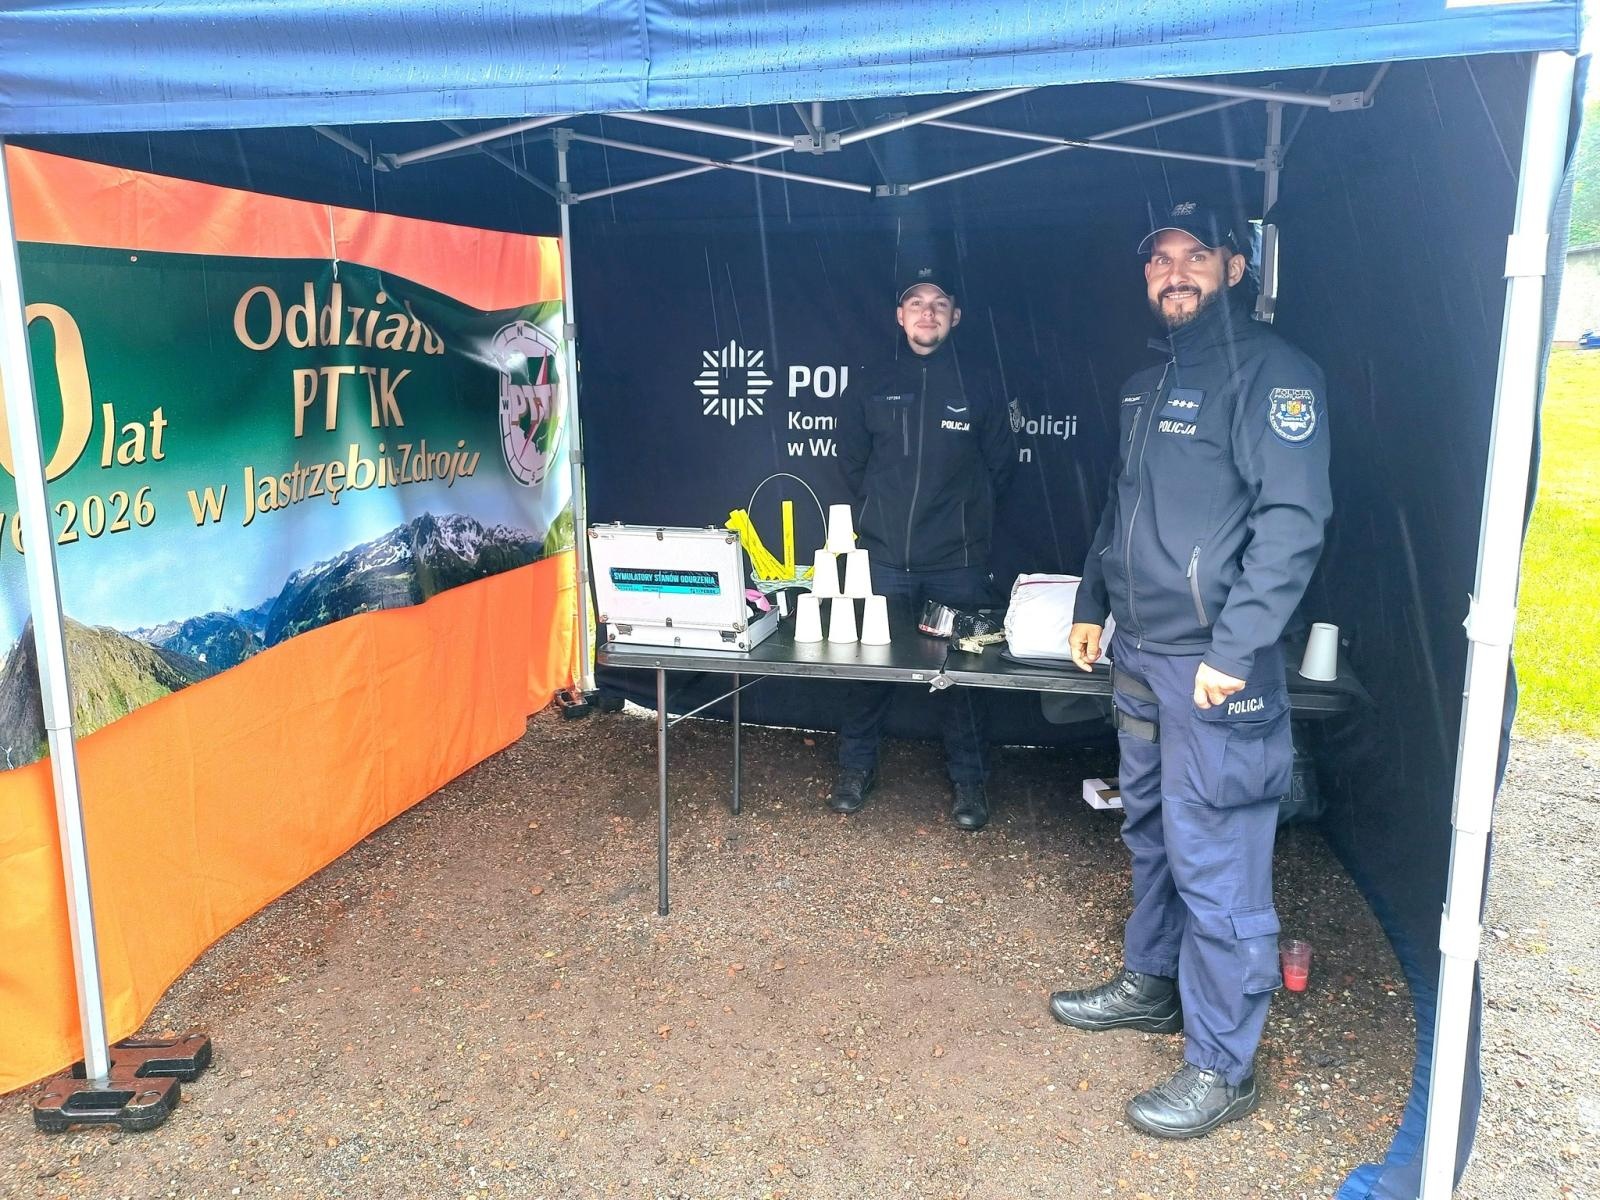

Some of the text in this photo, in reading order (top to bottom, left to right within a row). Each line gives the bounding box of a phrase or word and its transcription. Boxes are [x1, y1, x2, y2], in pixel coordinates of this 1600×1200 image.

[516, 326, 523, 337] N
[293, 365, 411, 439] PTTK
[502, 399, 509, 411] W
[508, 384, 558, 425] PTT
[788, 410, 838, 431] Kom
[941, 419, 970, 431] POLICJA
[1158, 420, 1197, 435] POLICJA
[101, 403, 168, 469] lat
[787, 442, 804, 457] w
[55, 485, 156, 546] 2026
[187, 484, 228, 527] w
[613, 572, 716, 585] SYMULATORY STANÓW ODURZENIA
[1228, 696, 1265, 716] POLICJA
